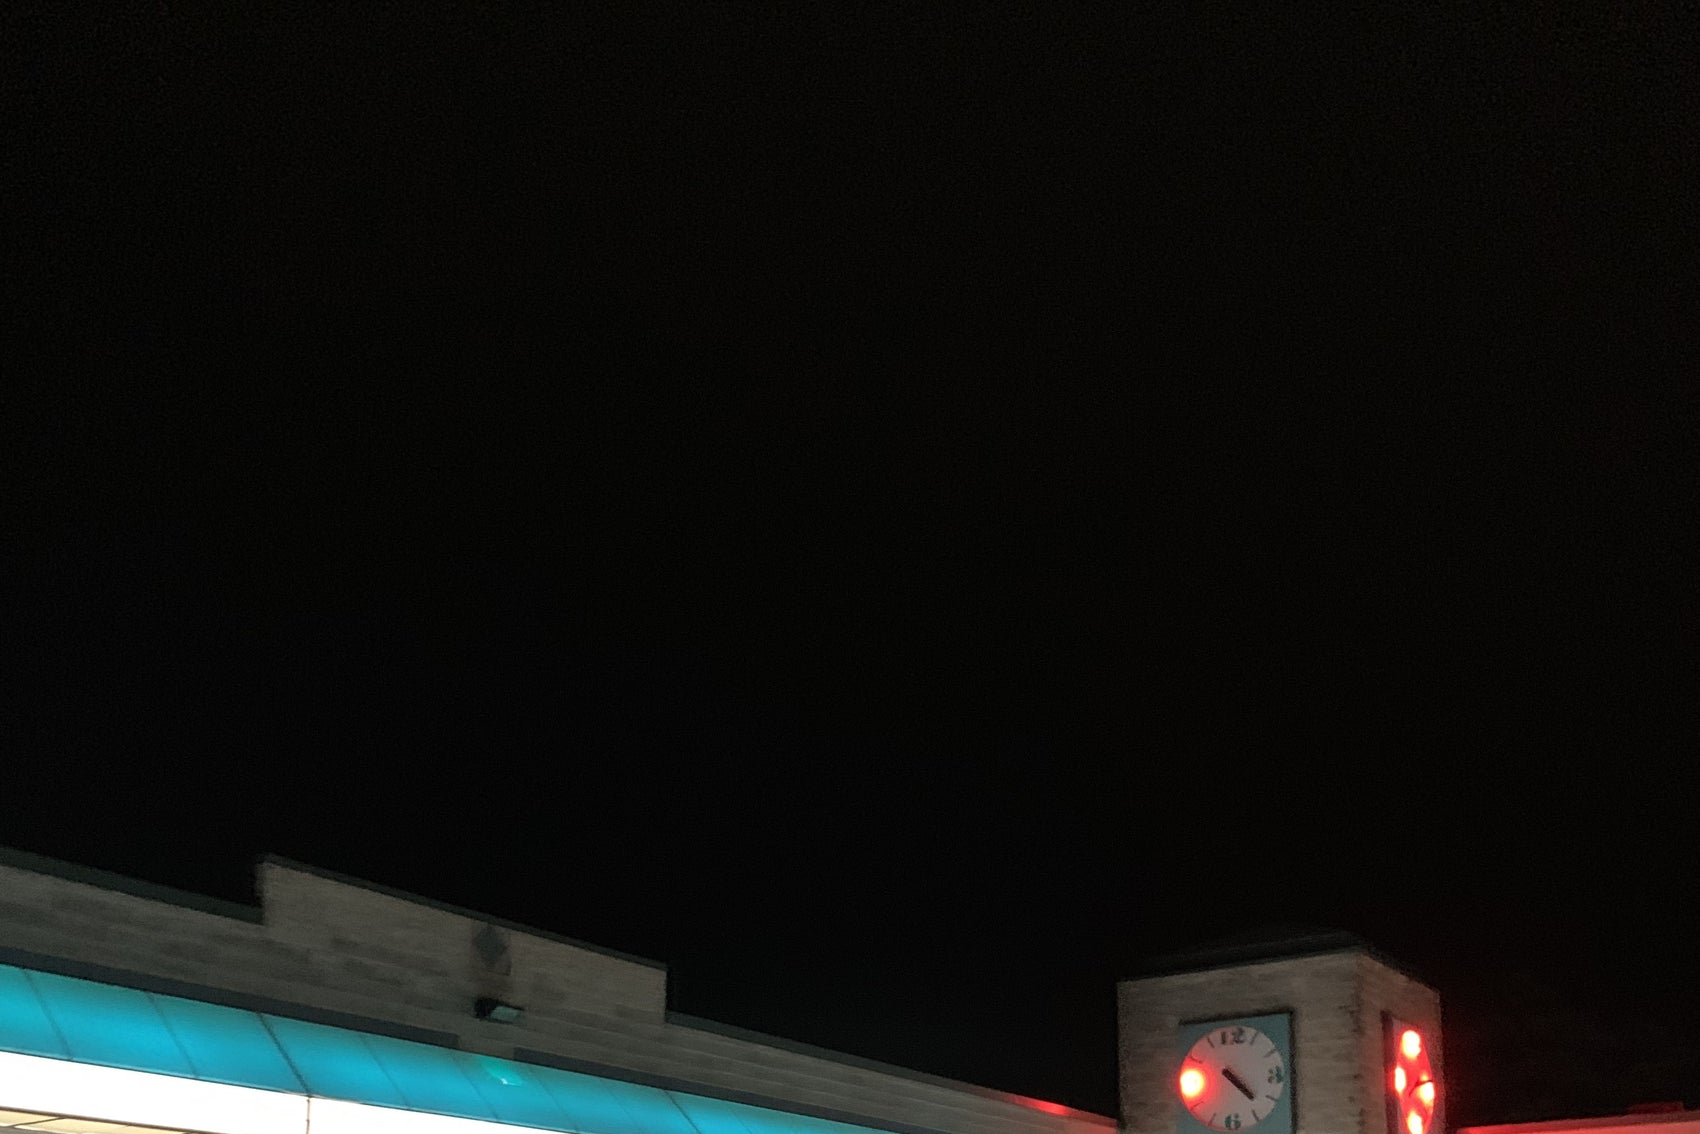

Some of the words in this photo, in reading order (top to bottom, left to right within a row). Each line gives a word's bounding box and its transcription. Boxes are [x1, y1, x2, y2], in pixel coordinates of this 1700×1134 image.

[1220, 1027, 1245, 1046] 12
[1267, 1065, 1284, 1084] 3
[1225, 1113, 1241, 1130] 6
